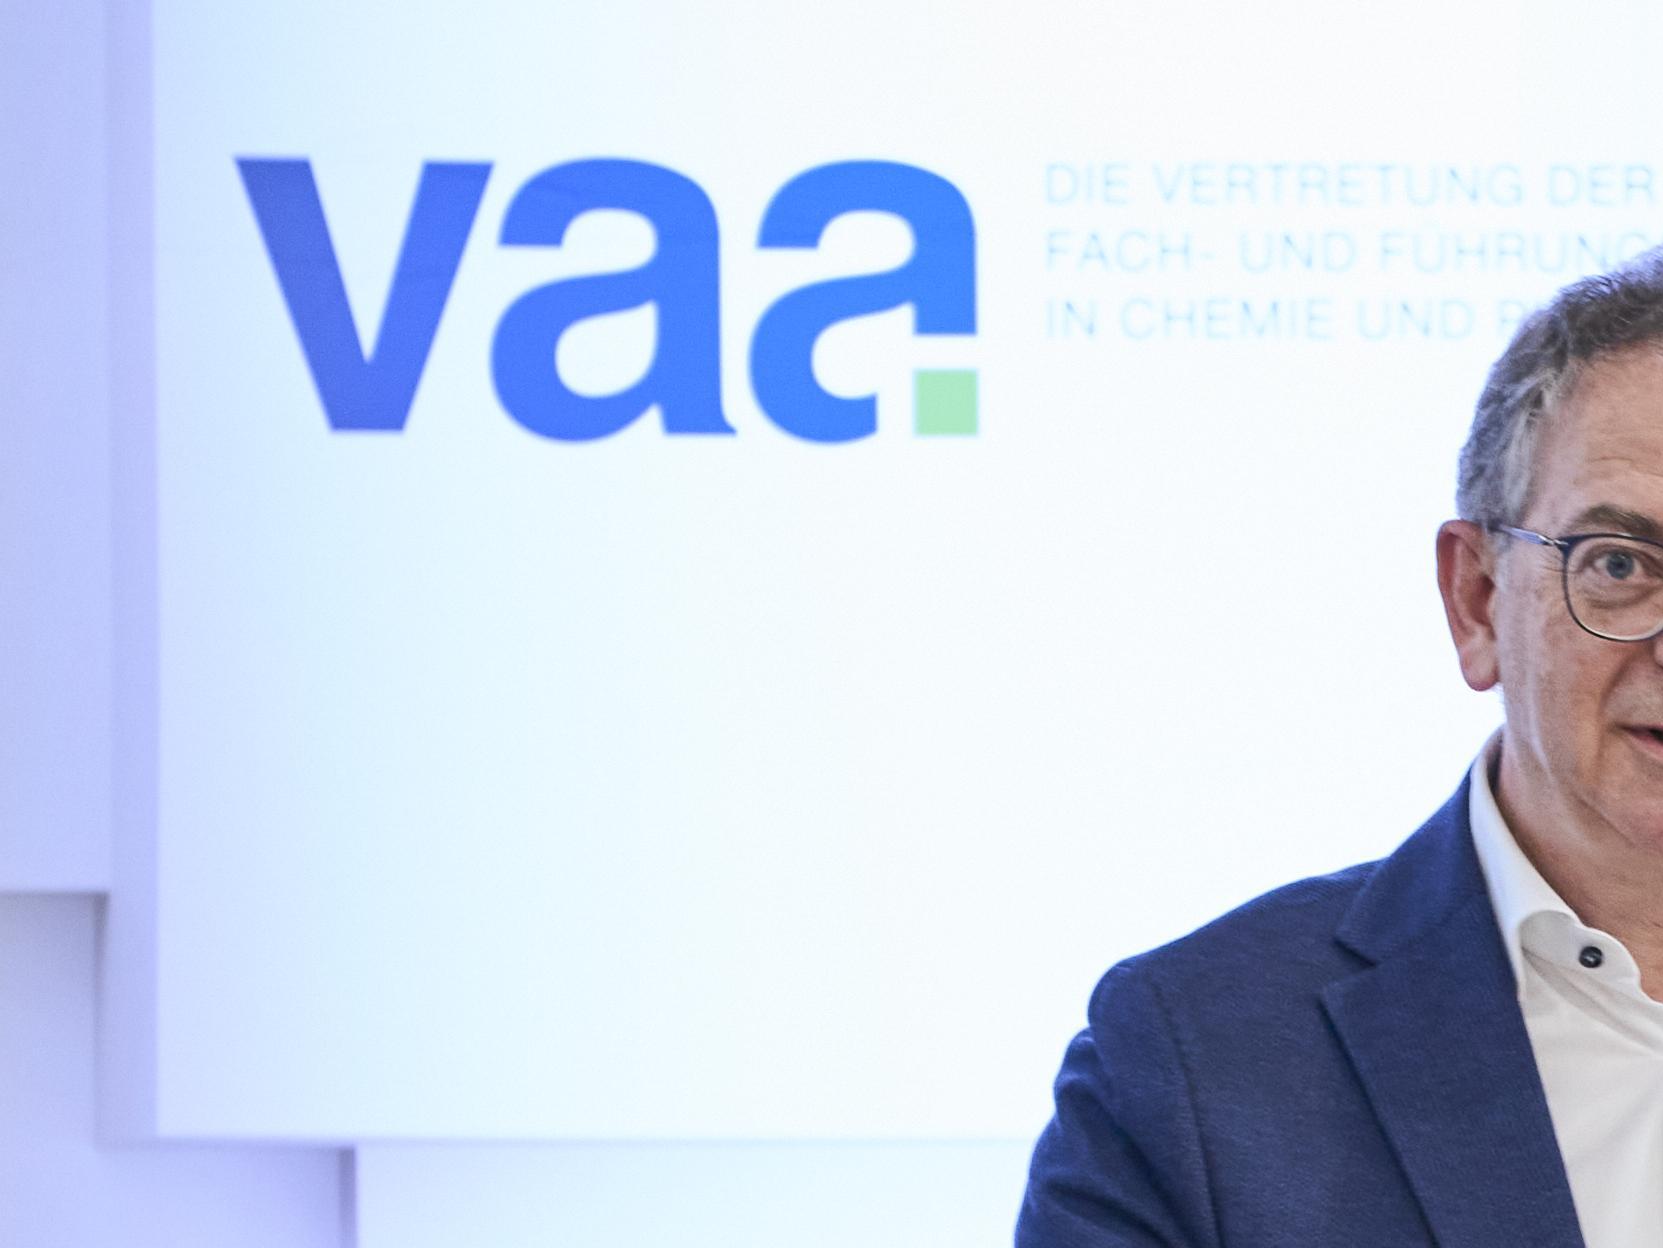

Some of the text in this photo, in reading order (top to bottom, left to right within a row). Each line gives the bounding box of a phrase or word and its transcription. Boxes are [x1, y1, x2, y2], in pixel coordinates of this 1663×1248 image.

[1044, 162, 1658, 207] DIE VERTRETUNG DER
[1044, 229, 1217, 273] FACH-
[1237, 229, 1358, 274] UND
[233, 157, 978, 444] vaa
[1044, 296, 1098, 340] IN
[1119, 296, 1336, 342] CHEMIE
[1356, 297, 1476, 342] UND
